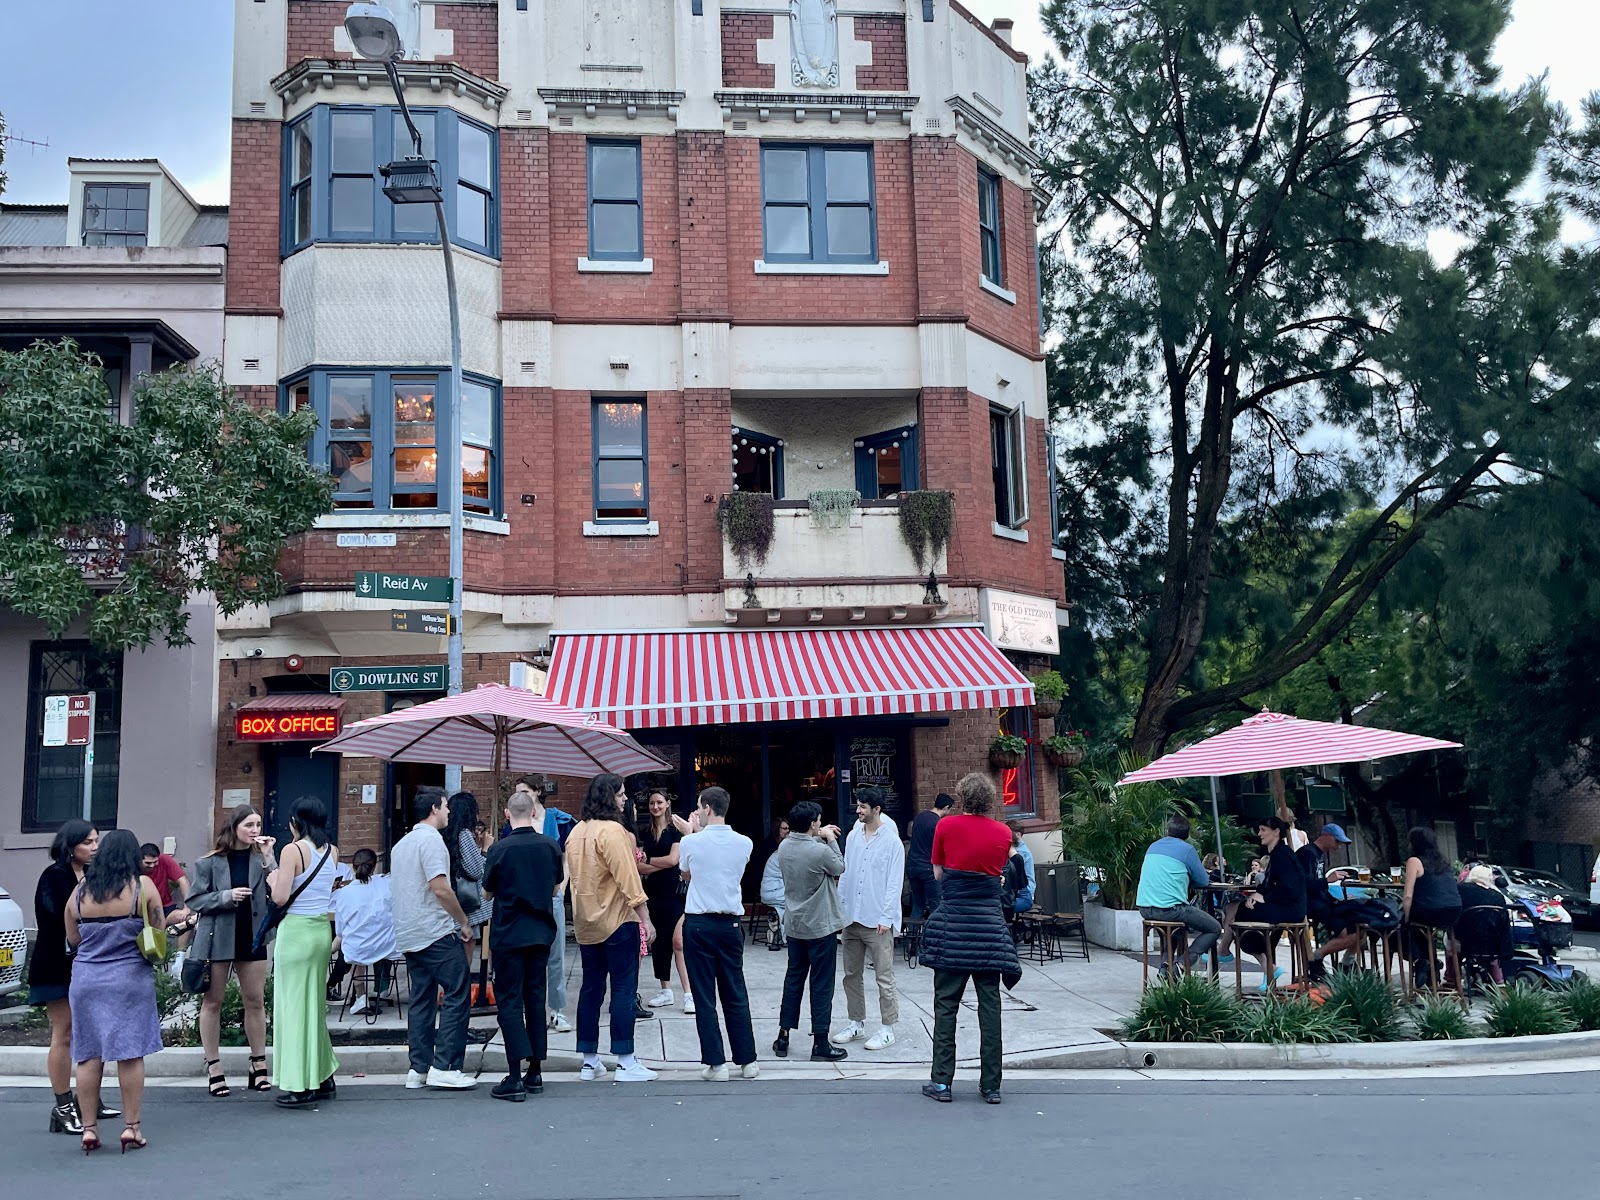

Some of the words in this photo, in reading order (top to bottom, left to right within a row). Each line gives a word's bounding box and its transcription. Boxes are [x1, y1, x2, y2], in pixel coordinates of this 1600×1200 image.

[340, 535, 377, 544] DOWLING
[383, 576, 409, 590] Reid
[411, 578, 428, 591] Av
[992, 602, 1007, 612] THE
[1008, 604, 1023, 615] OLD
[1024, 607, 1053, 620] FITZROY
[358, 673, 419, 685] DOWLING
[423, 672, 439, 684] ST
[242, 718, 275, 734] BOX
[279, 717, 335, 733] OFFICE
[853, 756, 890, 776] TRIVIA
